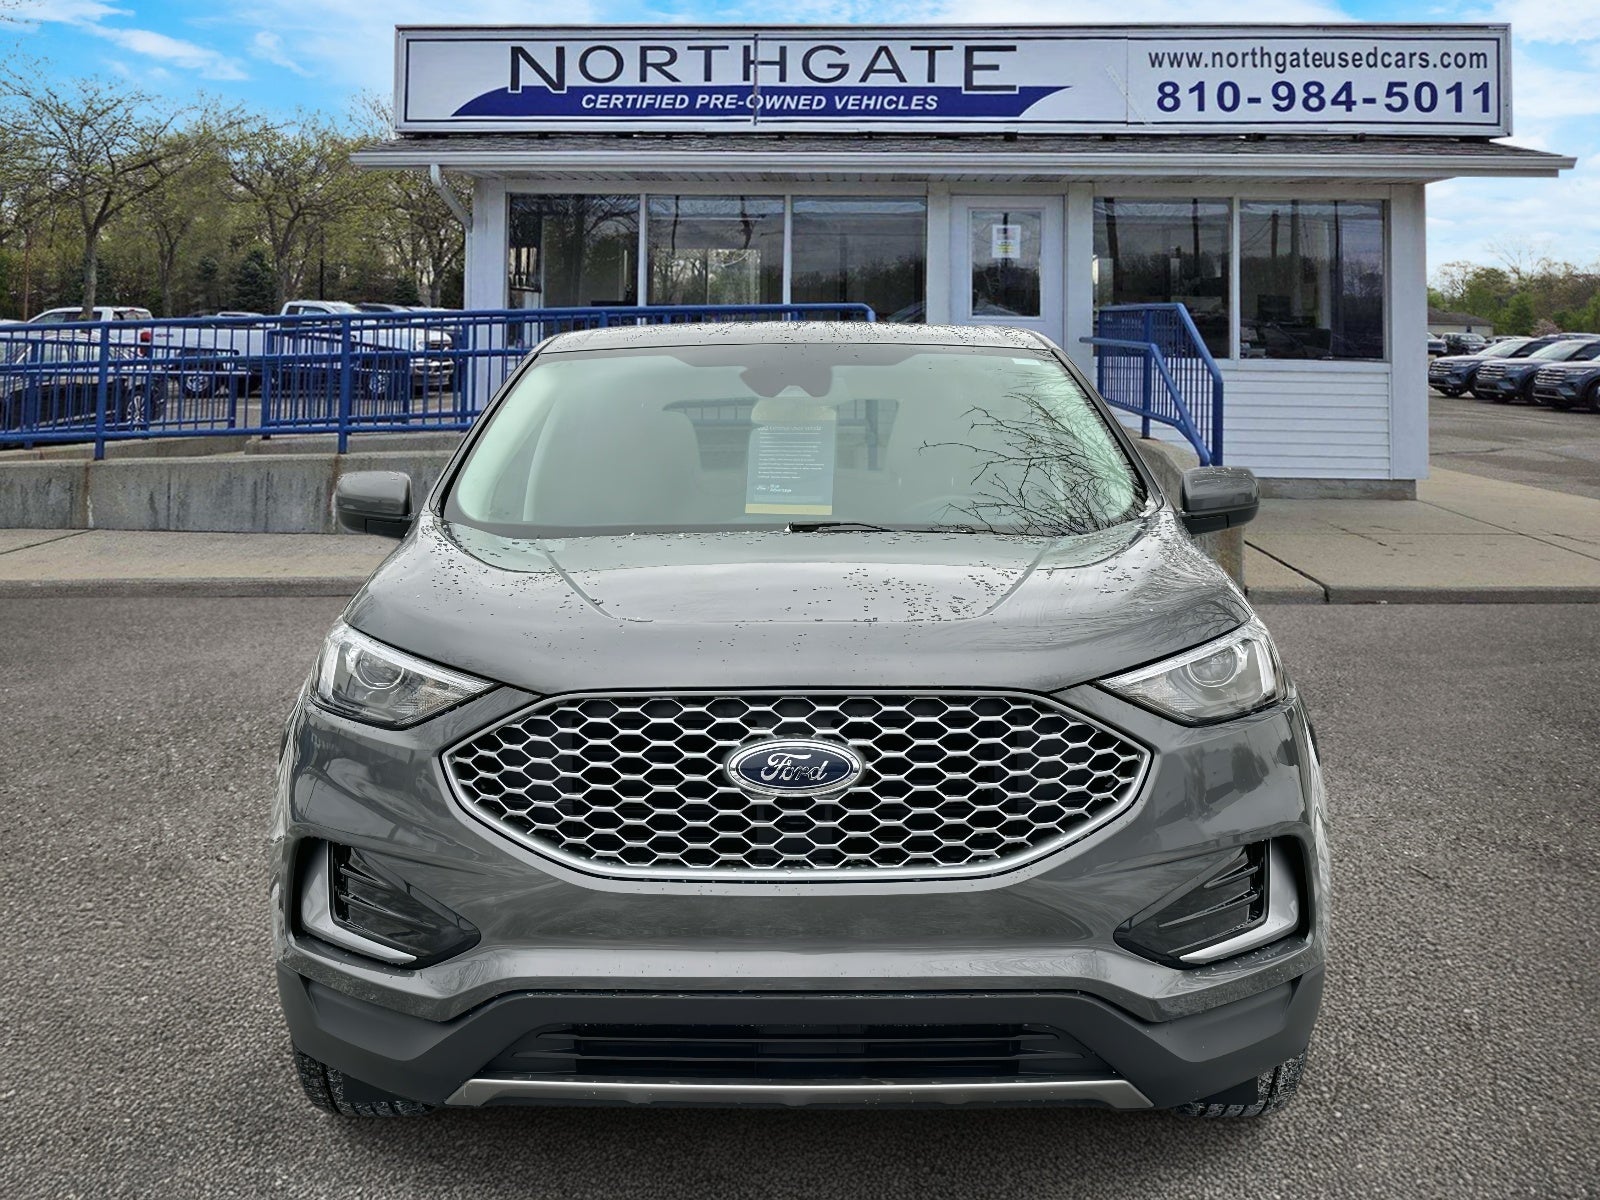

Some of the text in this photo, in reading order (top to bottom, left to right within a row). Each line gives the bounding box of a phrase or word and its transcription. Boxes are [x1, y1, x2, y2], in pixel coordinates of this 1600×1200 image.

[510, 45, 1017, 92] NORTHGATE
[1148, 46, 1489, 74] www.northgateusedcars.com
[581, 94, 939, 111] CERTIFIED PRE-OWNED VEHICLES
[1156, 80, 1491, 114] 810-984-5011
[760, 752, 829, 781] Ford
